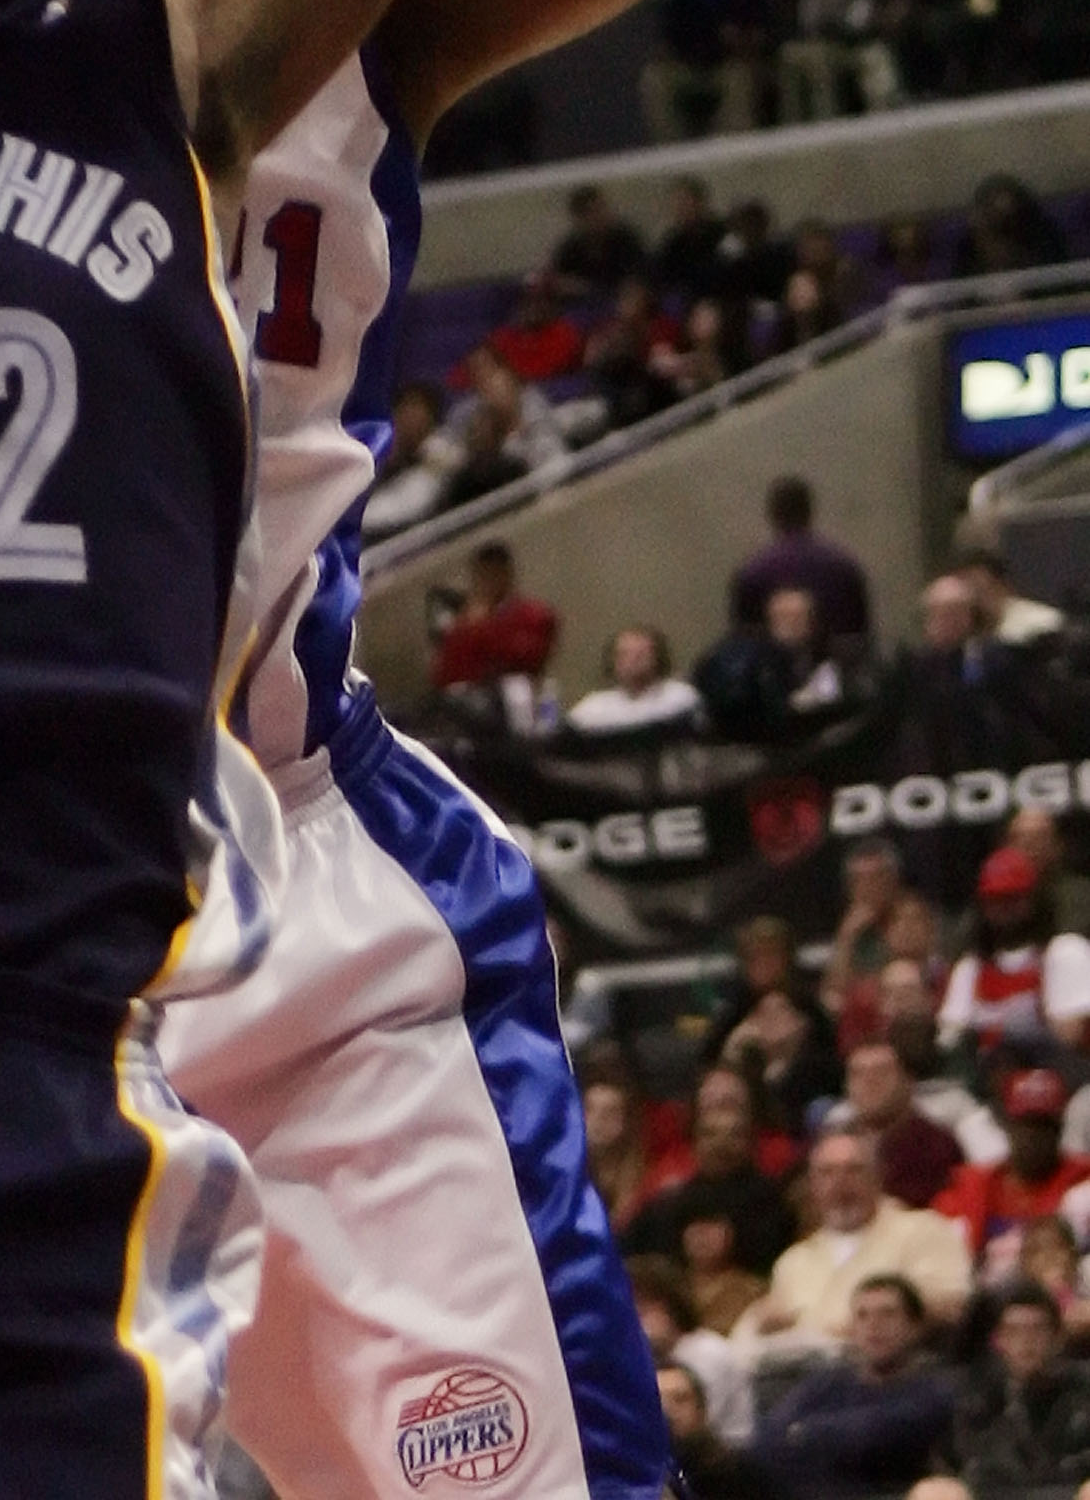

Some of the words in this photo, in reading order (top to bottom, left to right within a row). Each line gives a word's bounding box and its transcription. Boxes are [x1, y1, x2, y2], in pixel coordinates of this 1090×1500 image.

[229, 204, 324, 368] 1
[830, 759, 1090, 835] DODG
[397, 1415, 514, 1486] CLIPPERS
